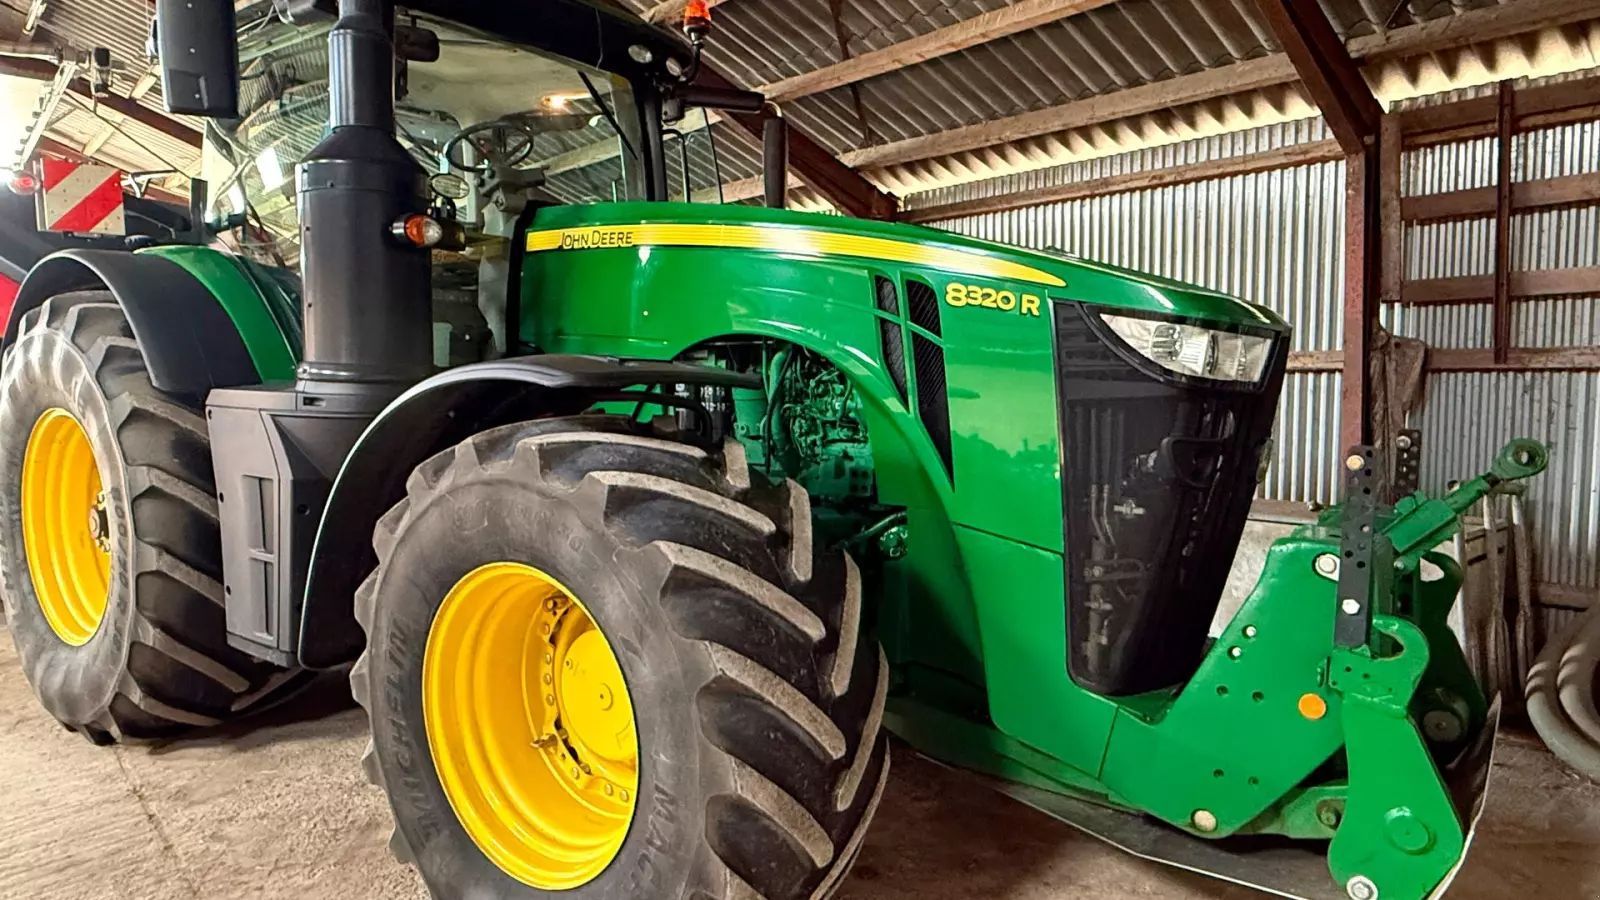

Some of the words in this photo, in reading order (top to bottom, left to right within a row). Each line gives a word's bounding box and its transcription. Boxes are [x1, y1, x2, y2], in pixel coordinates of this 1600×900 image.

[561, 232, 590, 249] JOHN
[591, 230, 634, 247] DEERE
[945, 282, 1017, 311] 8320
[1021, 293, 1041, 317] R
[385, 616, 433, 821] MICHELIN
